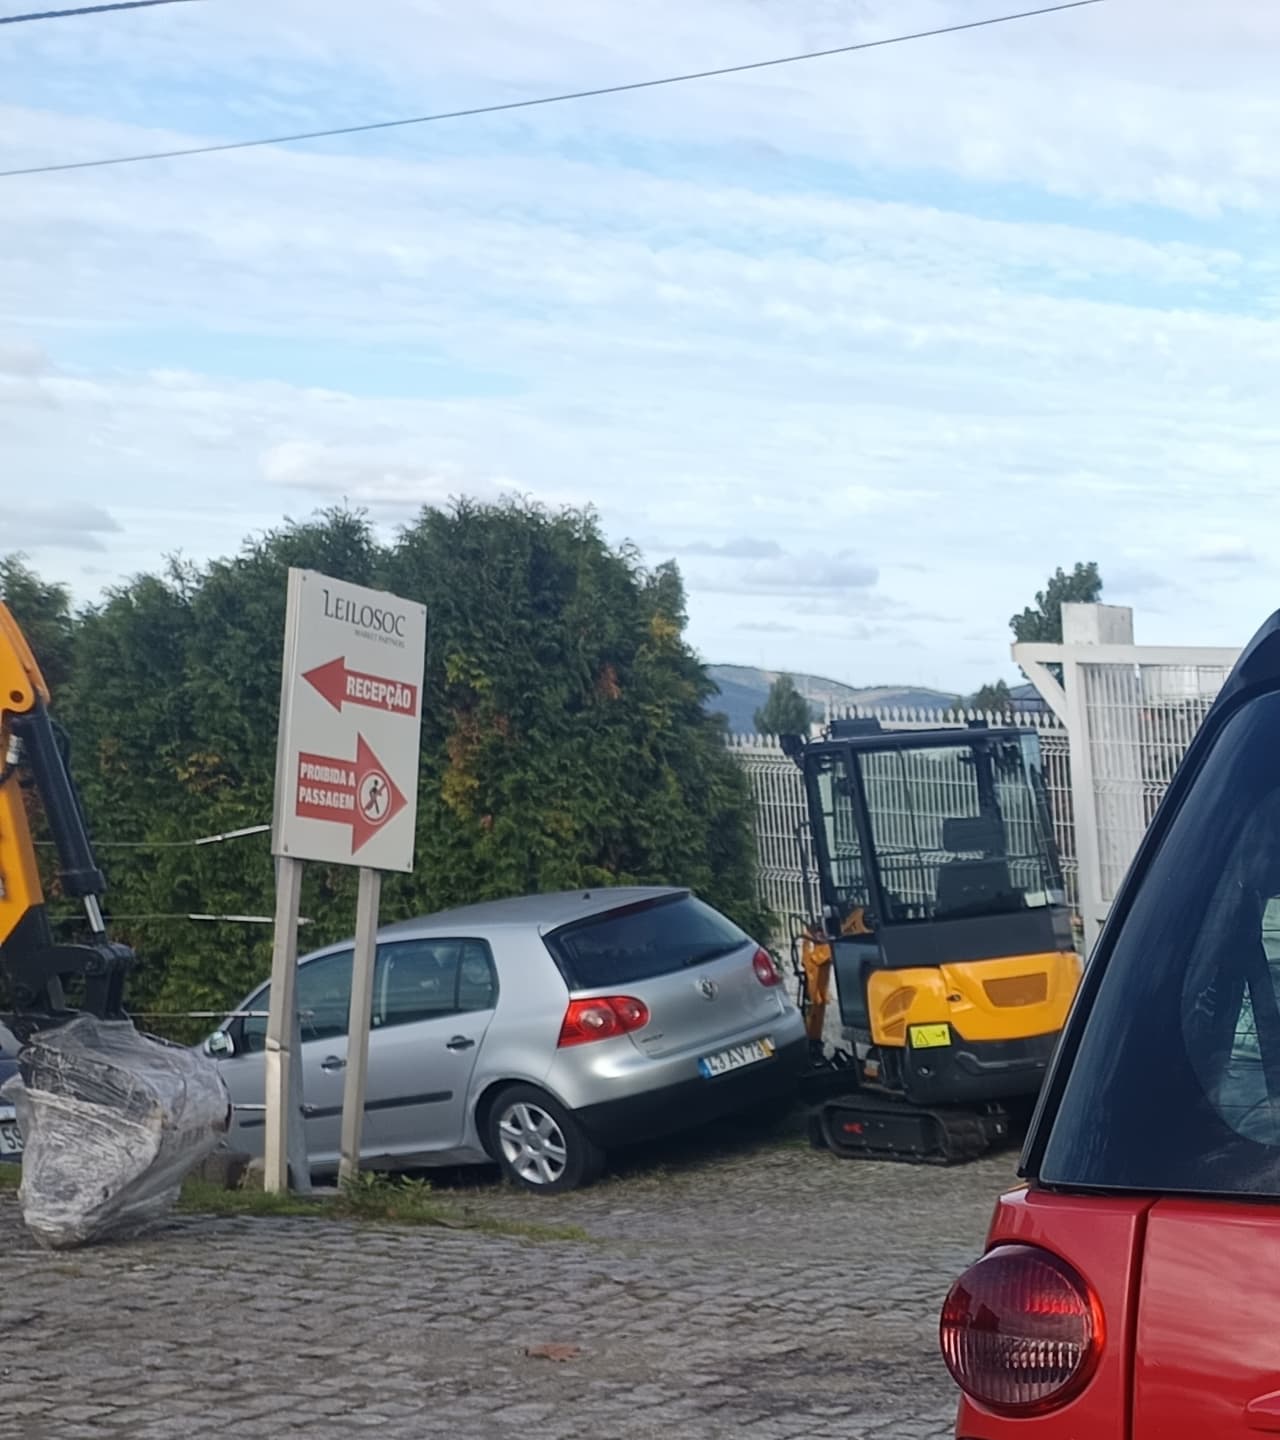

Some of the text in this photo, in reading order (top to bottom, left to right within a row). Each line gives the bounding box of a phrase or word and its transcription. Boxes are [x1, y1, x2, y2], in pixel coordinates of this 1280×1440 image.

[323, 589, 406, 637] LEILOSOC
[346, 676, 412, 709] RECEPÇÃO
[300, 762, 356, 787] PROIBIDA A
[299, 786, 355, 810] PASSAGEM
